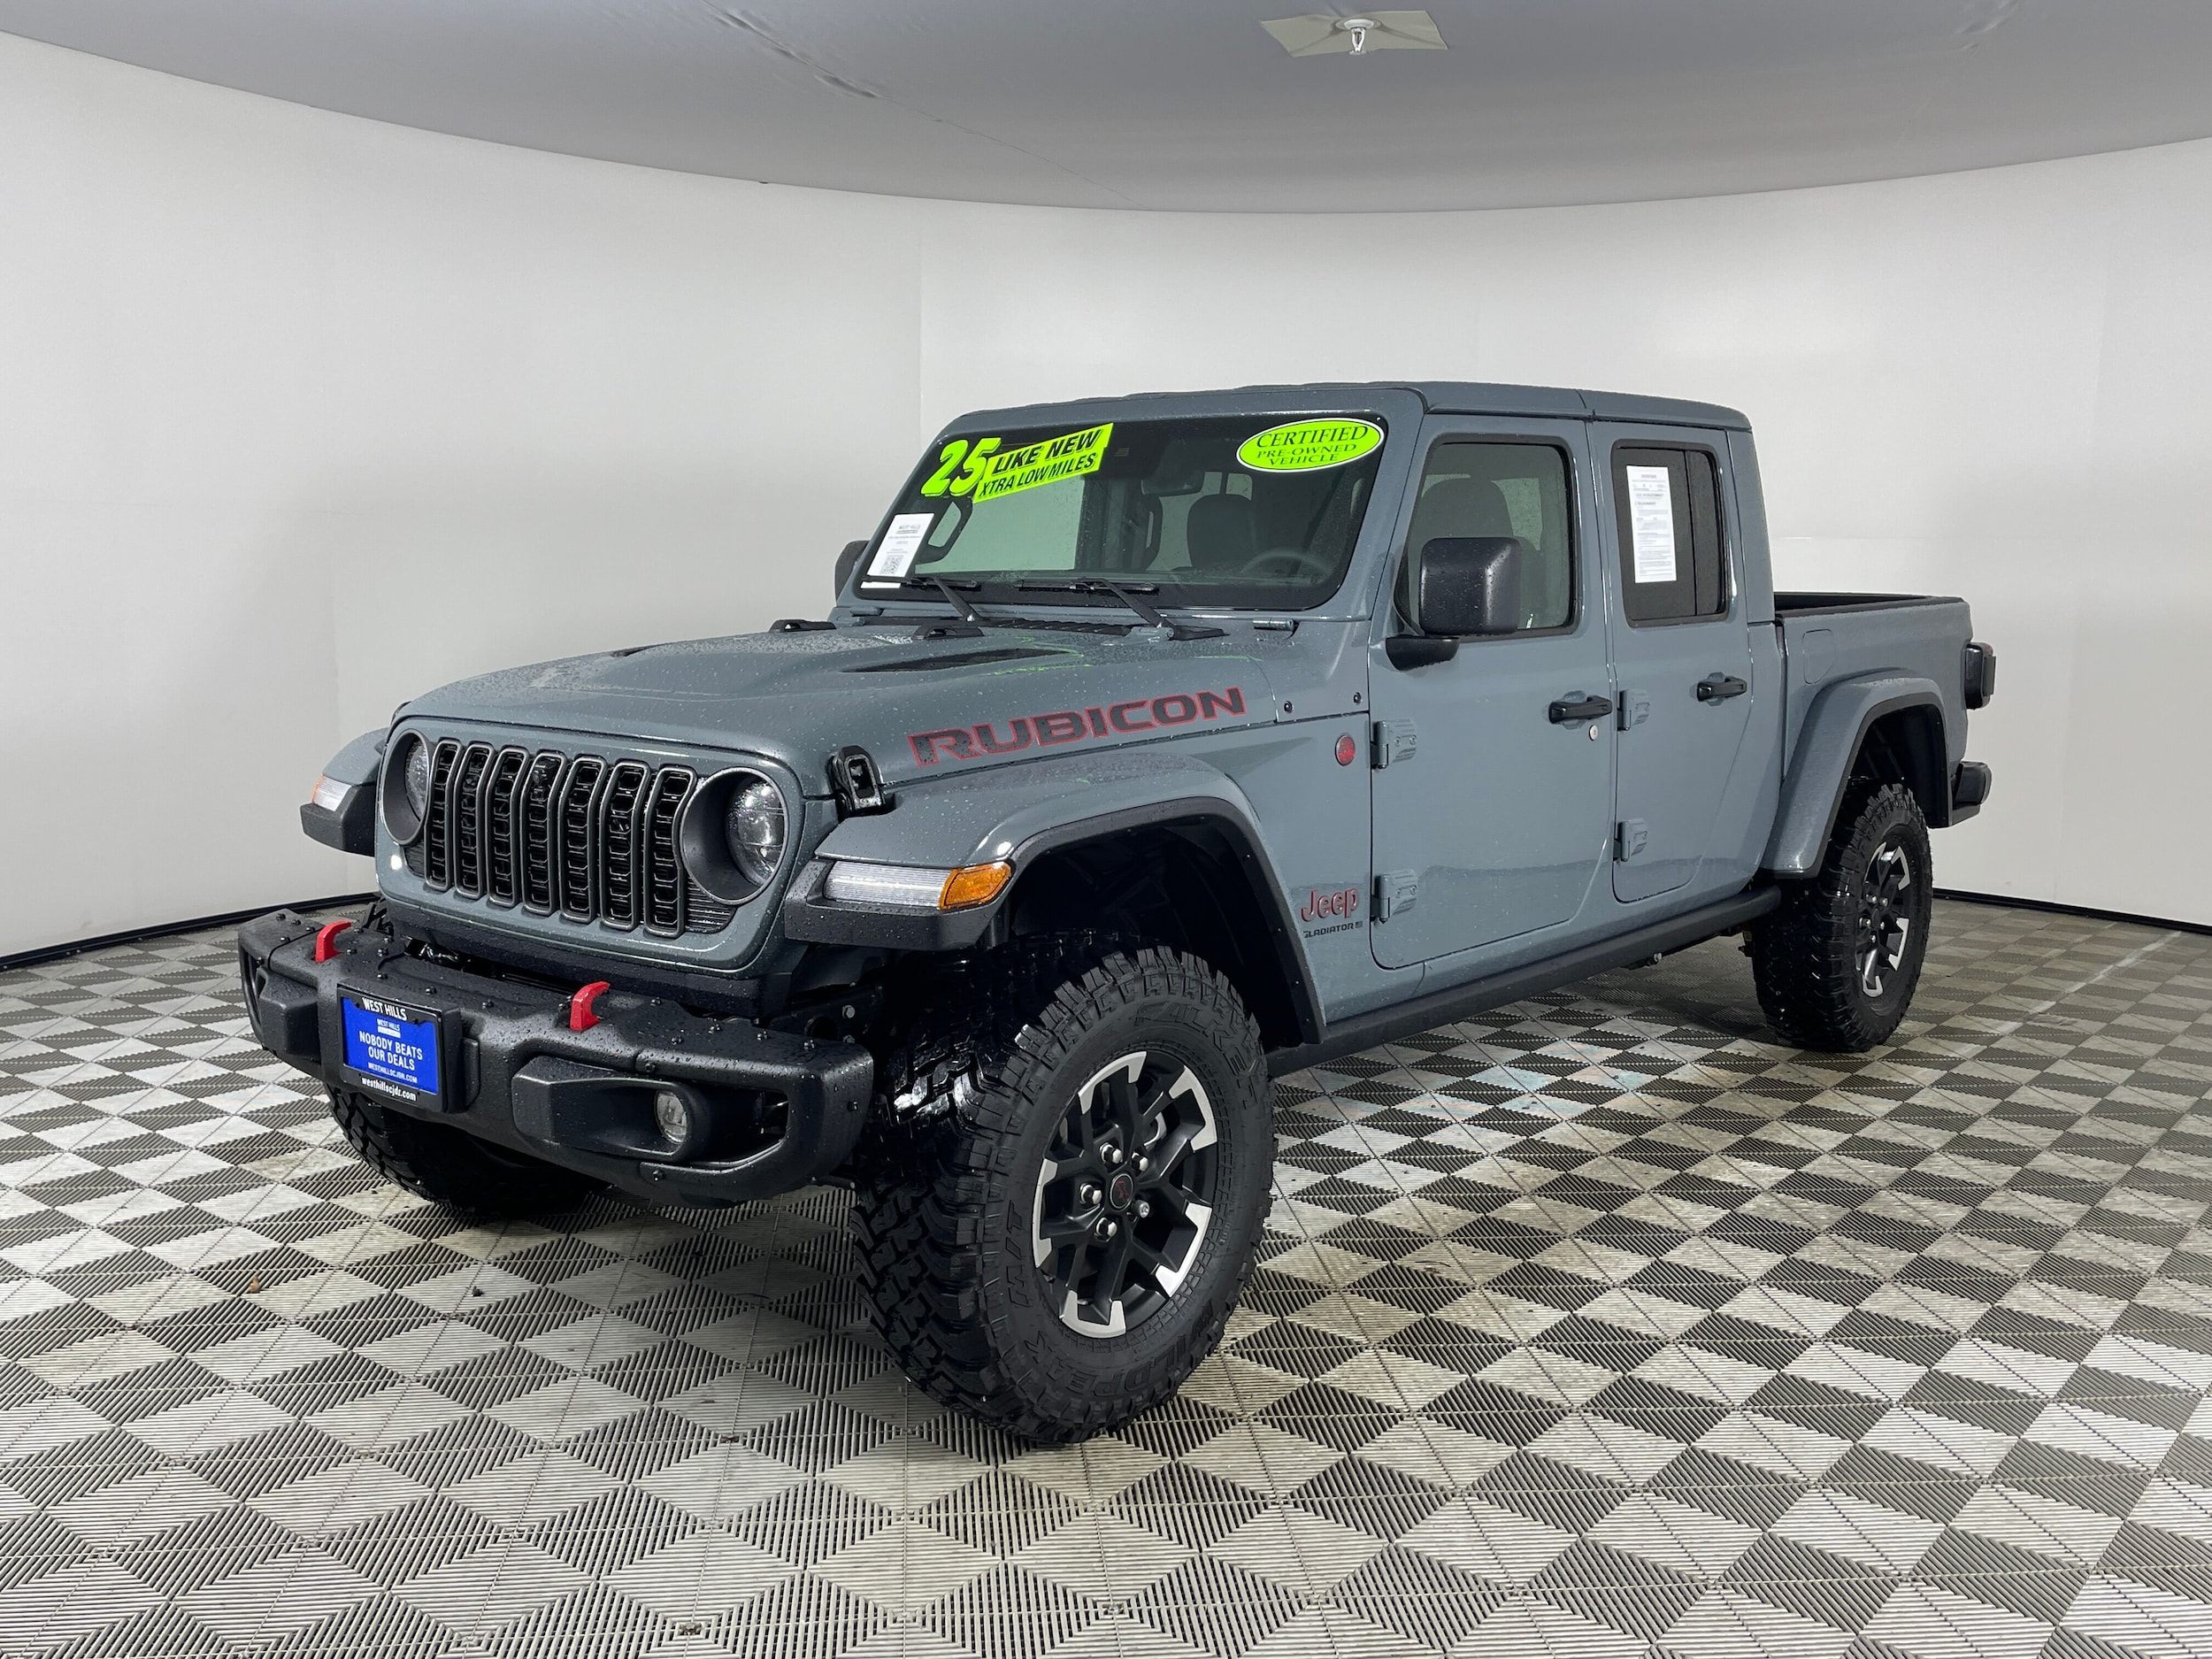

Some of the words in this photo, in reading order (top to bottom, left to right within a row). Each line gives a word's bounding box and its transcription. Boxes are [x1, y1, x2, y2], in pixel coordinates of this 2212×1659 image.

[1257, 426, 1369, 448] CERTIFIED
[992, 446, 1043, 474] LIKE
[1046, 429, 1102, 460] NEW
[1256, 444, 1357, 458] PRE-OWNED
[1270, 454, 1340, 465] VEHICLE
[921, 438, 1002, 497] 25
[979, 474, 1016, 497] XTRA
[1017, 465, 1049, 487] LOW
[1048, 452, 1097, 479] MILES
[908, 686, 1247, 767] RUBICON
[1301, 888, 1359, 922] Jeep
[1303, 922, 1354, 938] GLADIATOR
[362, 997, 384, 1016] WEST
[384, 1004, 407, 1021] HILLS
[358, 1031, 393, 1051] NOBODY
[395, 1041, 423, 1060] BEATS
[368, 1047, 386, 1062] OUR
[388, 1052, 415, 1071] DEALS
[361, 1077, 416, 1102] westhillscjdr.com
